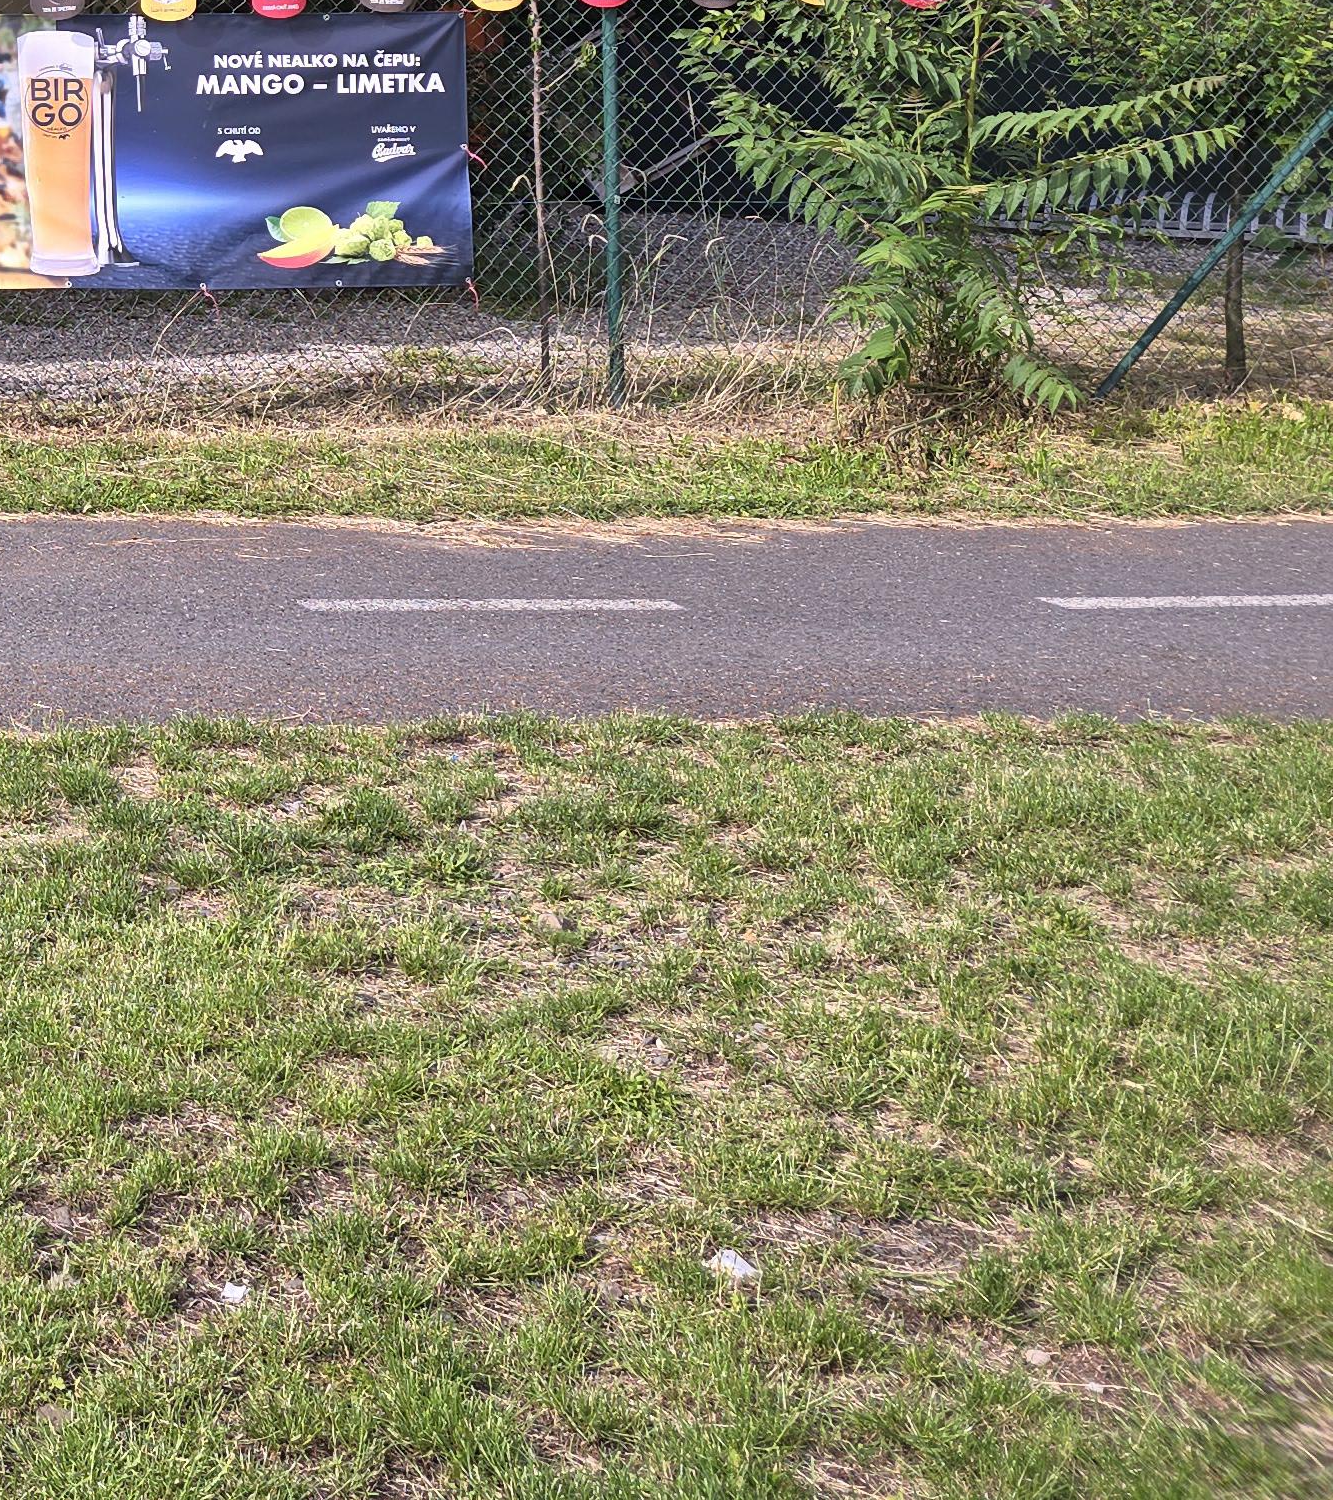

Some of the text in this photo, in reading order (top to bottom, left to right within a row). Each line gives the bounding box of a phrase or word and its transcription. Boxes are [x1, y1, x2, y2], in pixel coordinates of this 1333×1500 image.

[213, 49, 421, 69] NOVÉ NEALKO NA ČEPU:
[30, 78, 84, 102] BIR
[196, 73, 305, 95] MANGO
[336, 73, 446, 94] LIMETKA
[31, 102, 83, 127] GO
[217, 127, 223, 135] S
[371, 123, 416, 134] UVAŘENO V
